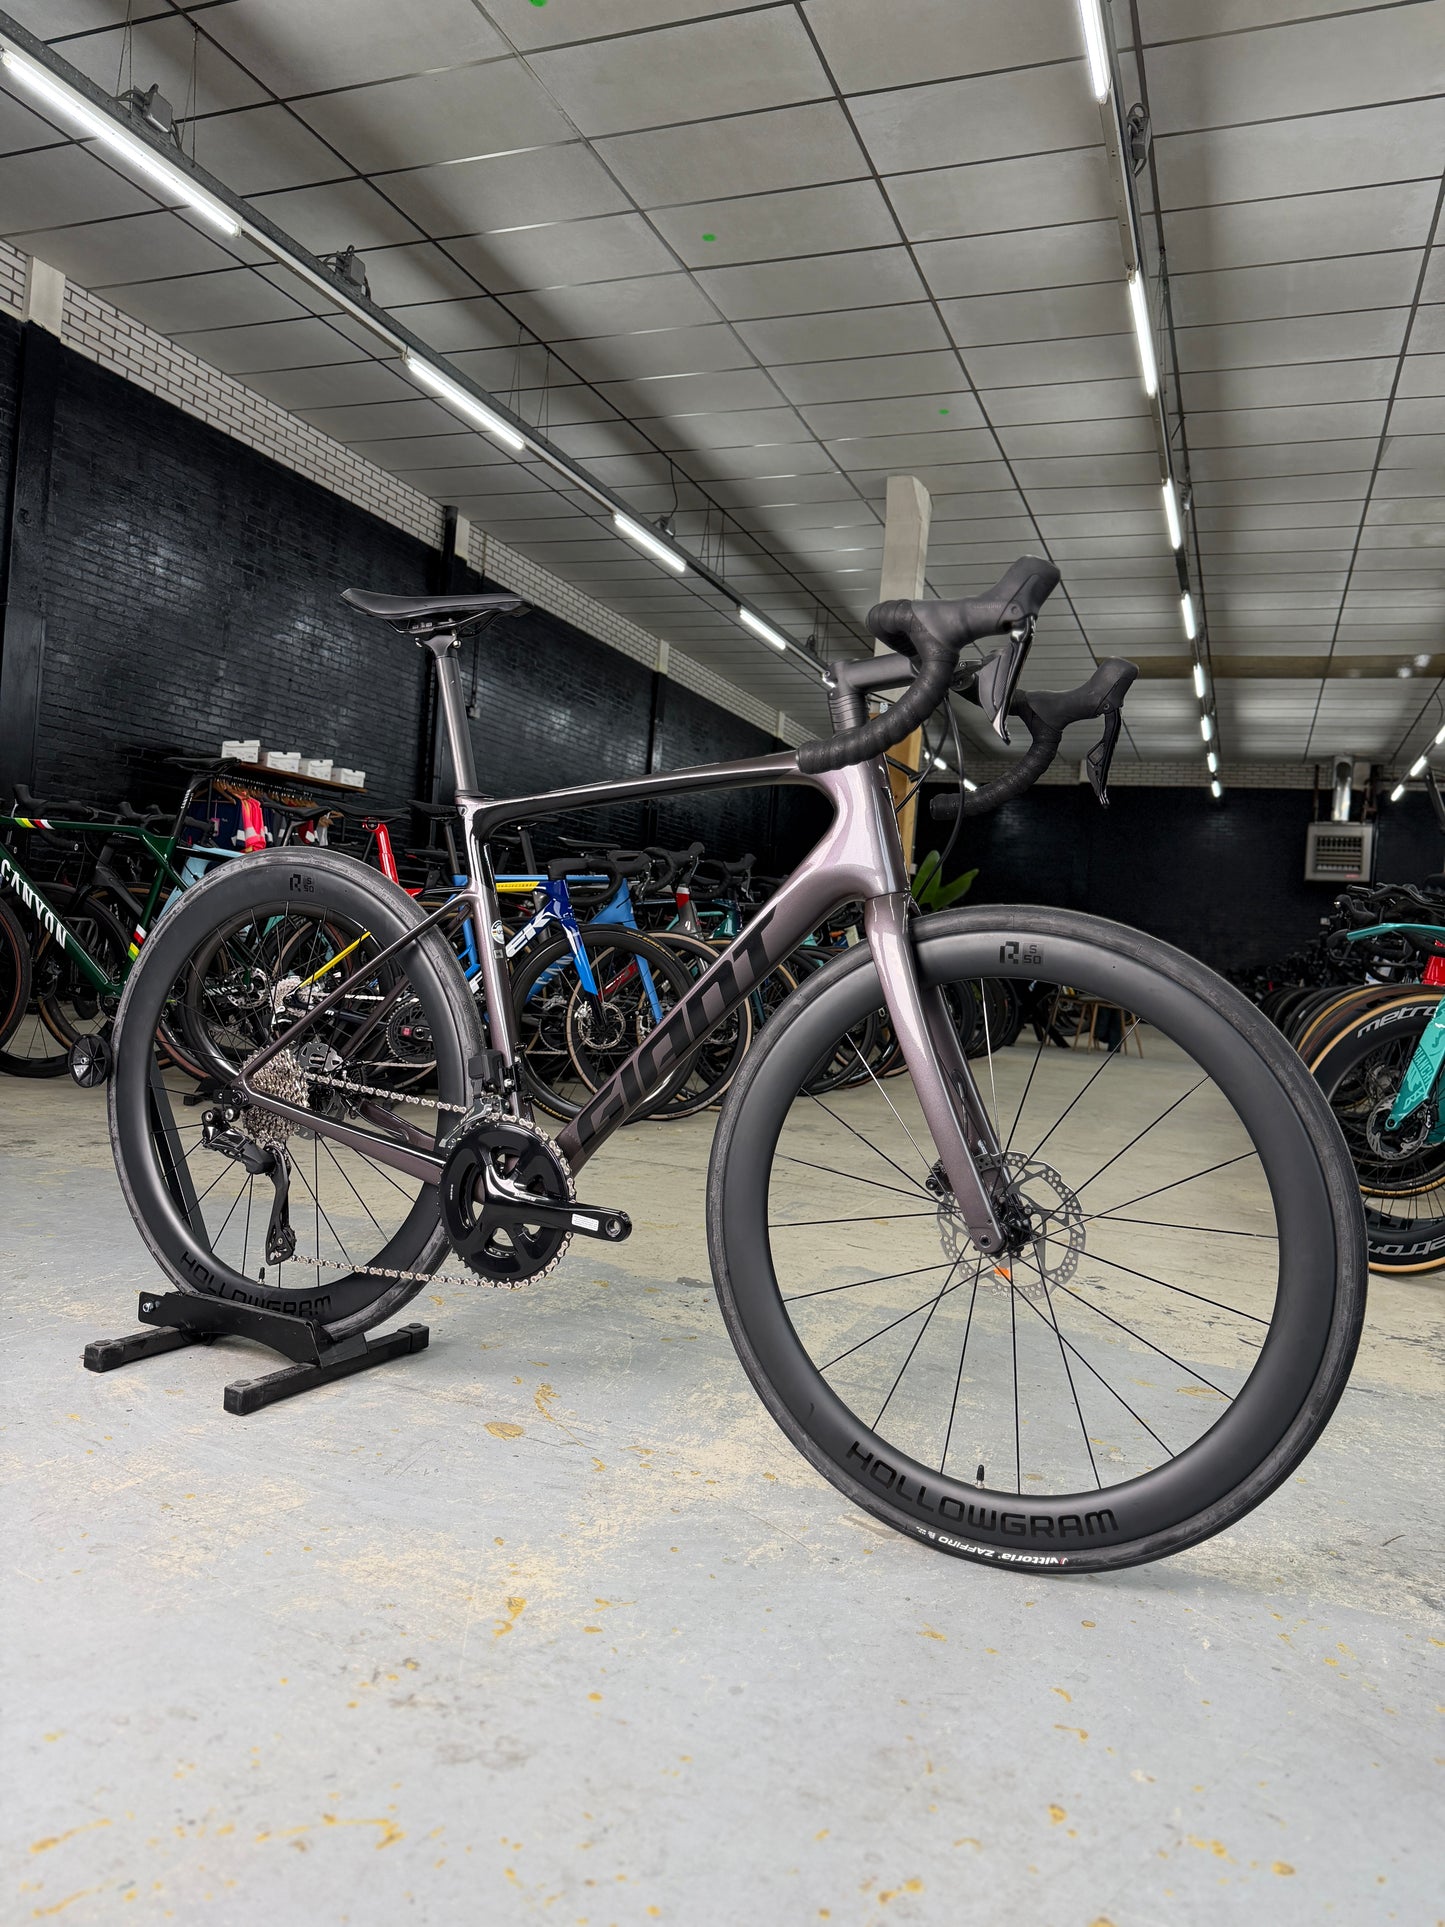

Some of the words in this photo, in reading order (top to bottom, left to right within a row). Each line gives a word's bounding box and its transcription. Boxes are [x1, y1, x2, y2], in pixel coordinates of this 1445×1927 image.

[1, 859, 67, 950] CANYON
[576, 906, 777, 1151] GIANT
[181, 1252, 331, 1317] HOLLOWGRAM
[846, 1440, 1119, 1538] HOLLOWGRAM
[938, 1536, 995, 1557] ZAFFIRO
